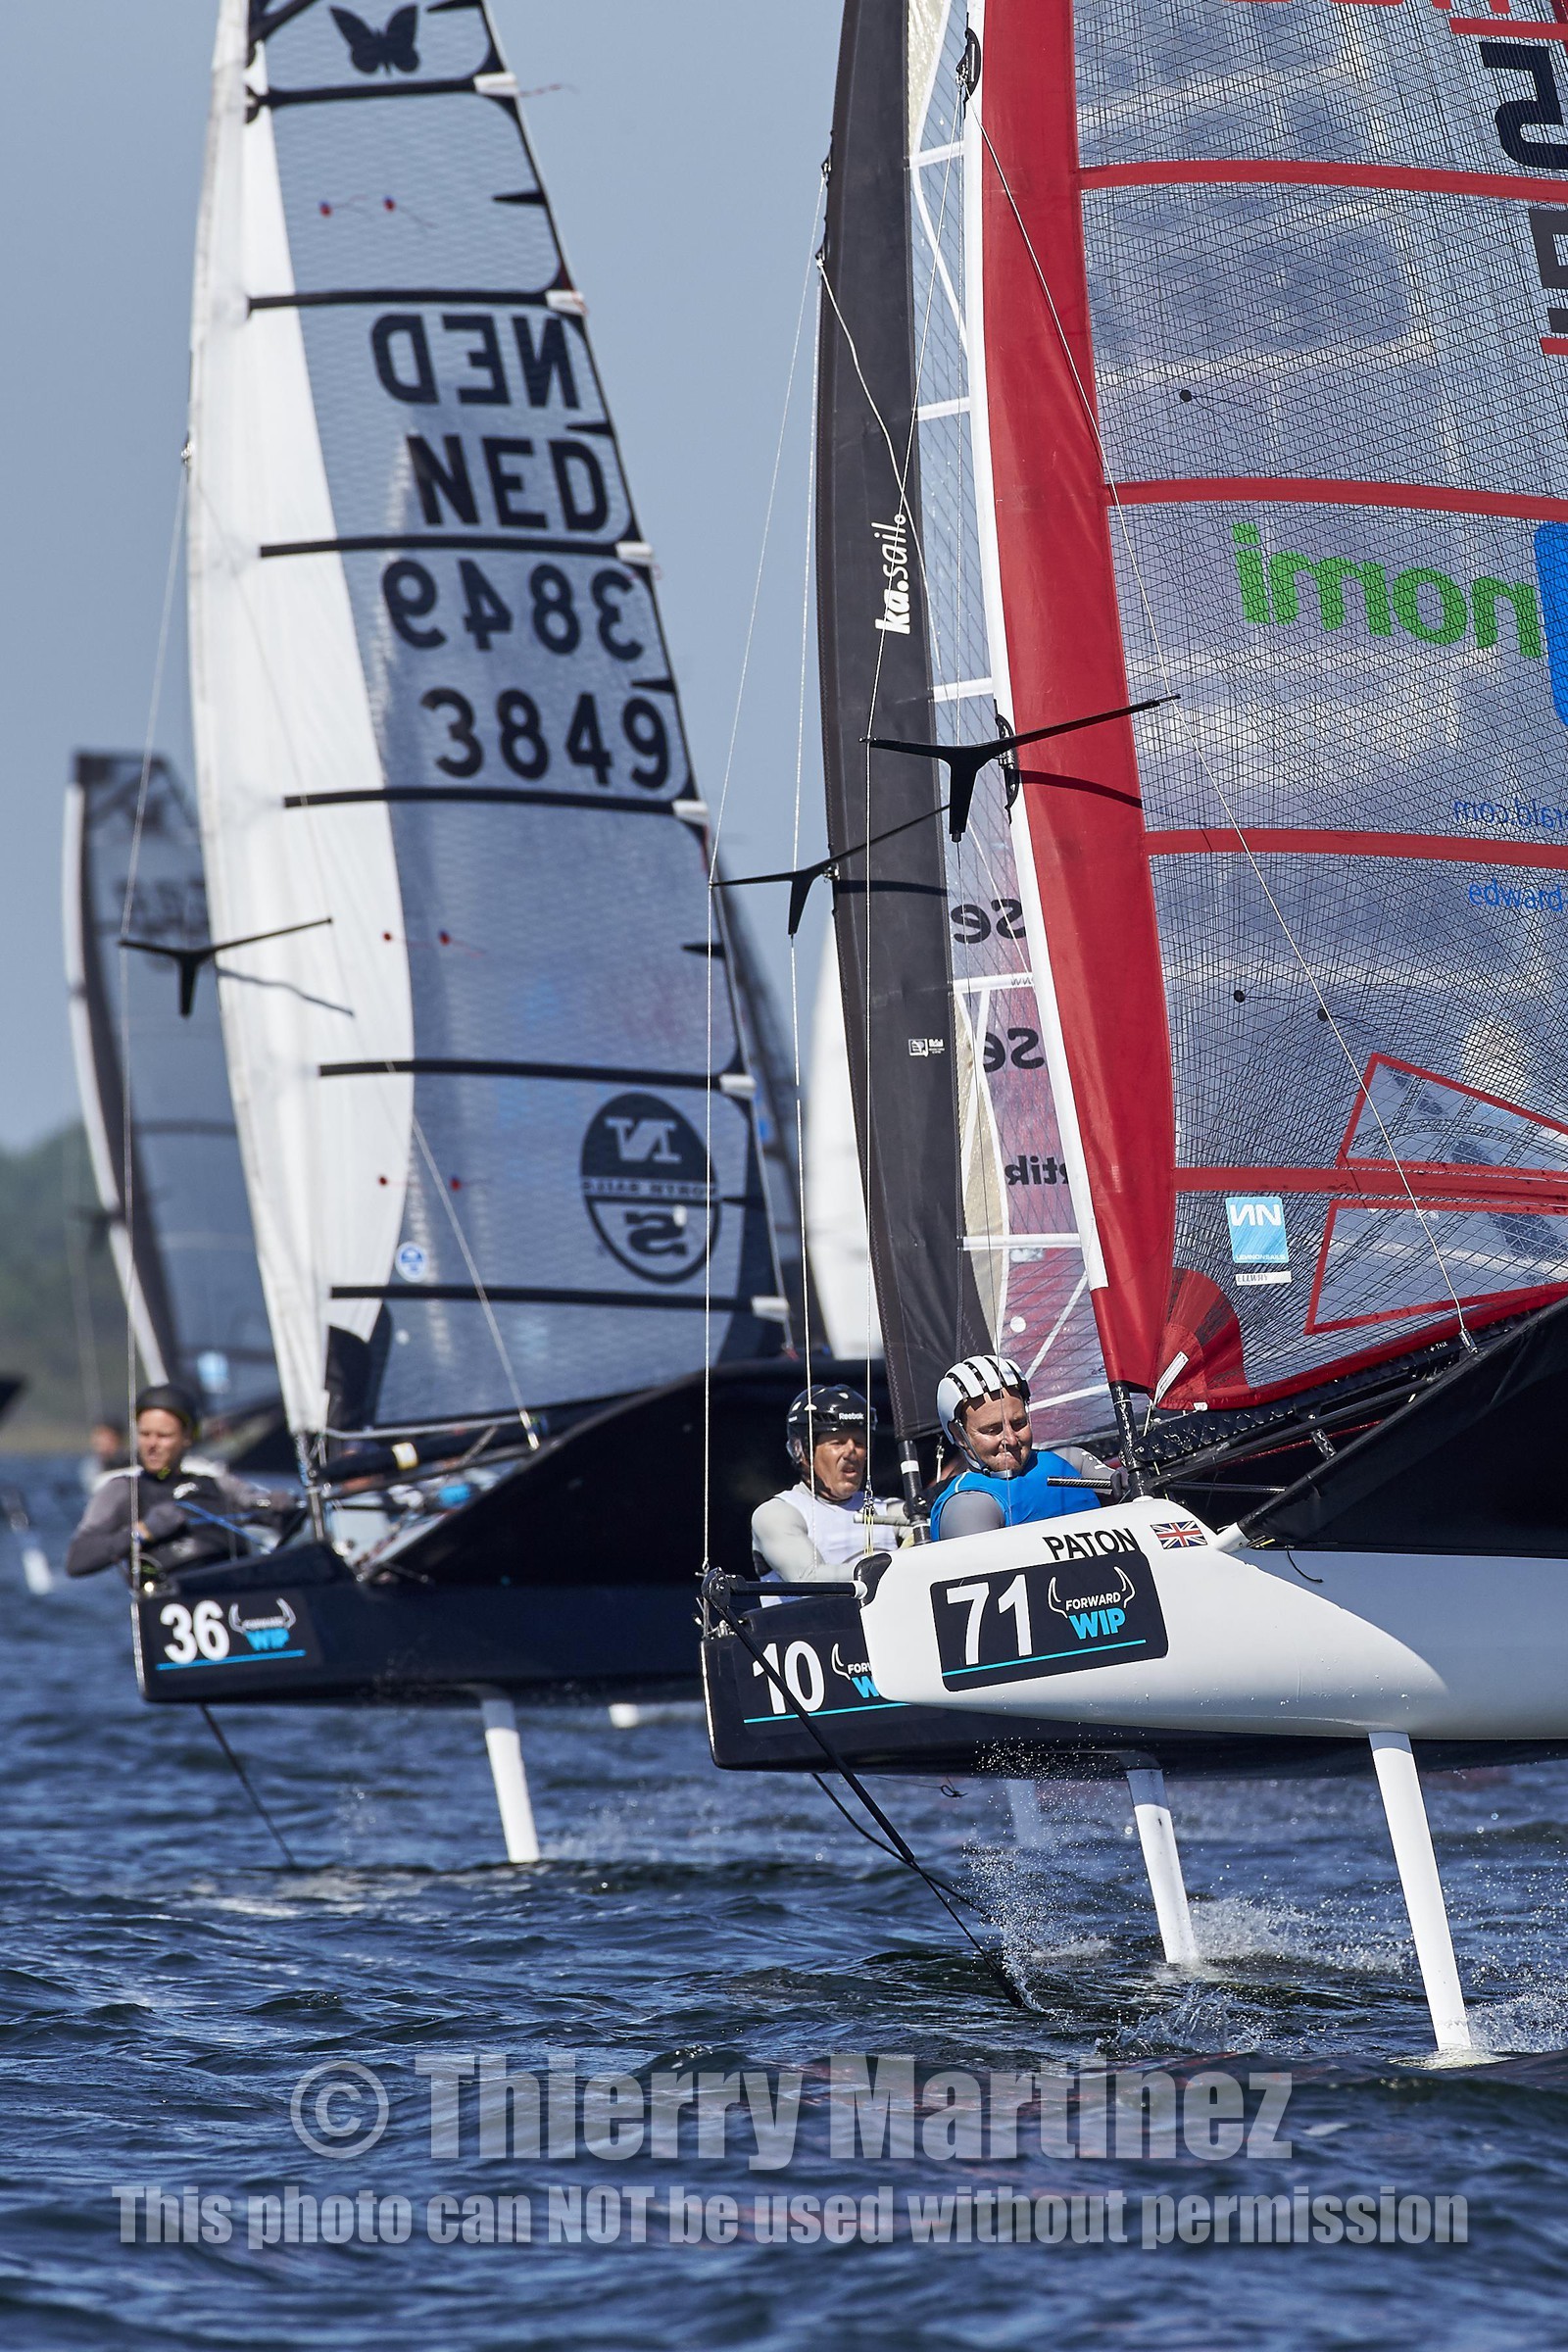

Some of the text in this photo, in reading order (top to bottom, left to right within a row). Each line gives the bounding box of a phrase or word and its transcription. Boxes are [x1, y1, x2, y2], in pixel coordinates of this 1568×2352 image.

[405, 434, 609, 533] NED
[420, 687, 669, 790] 3849
[1042, 1528, 1142, 1560] PATON
[160, 1600, 229, 1664] 36
[947, 1574, 1032, 1665] 71
[1065, 1592, 1121, 1610] FORWARD
[1067, 1607, 1125, 1641] WIP
[753, 1641, 825, 1714] 10
